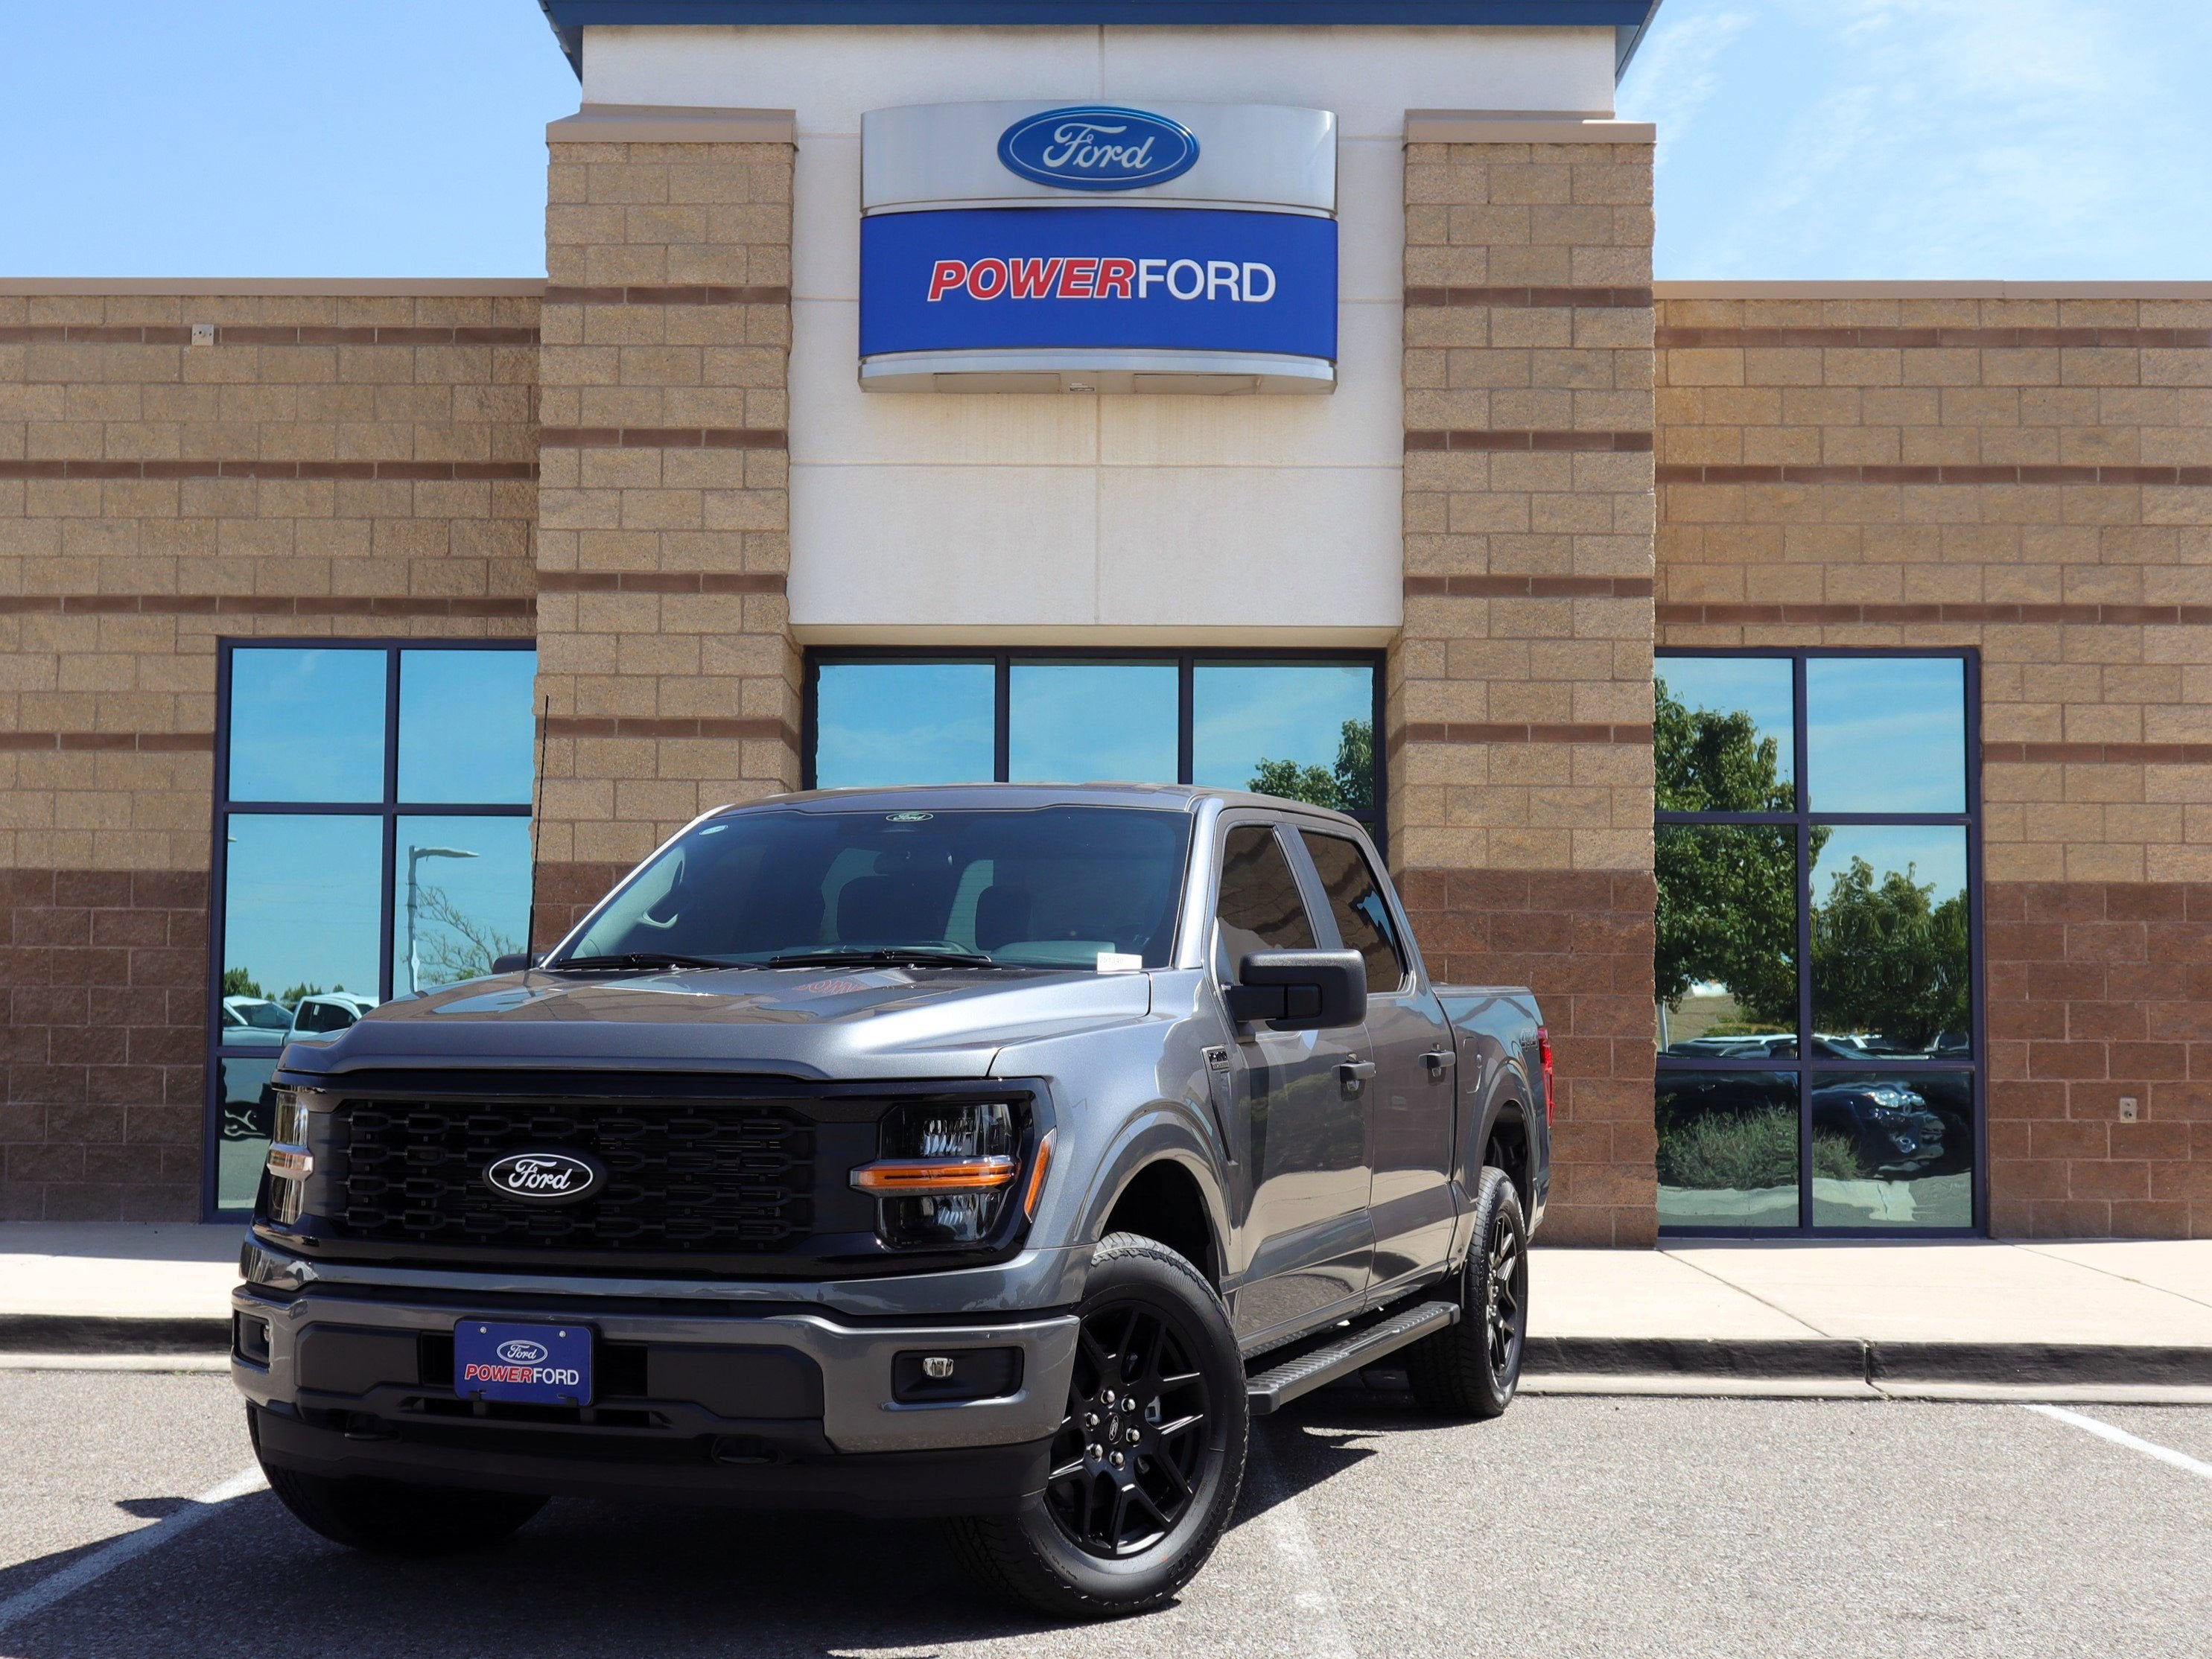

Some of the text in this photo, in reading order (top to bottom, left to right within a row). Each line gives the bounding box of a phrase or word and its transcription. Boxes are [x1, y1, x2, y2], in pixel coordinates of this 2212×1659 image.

[1043, 122, 1156, 169] Ford
[508, 1159, 573, 1190] Ford
[507, 1343, 538, 1360] Ford
